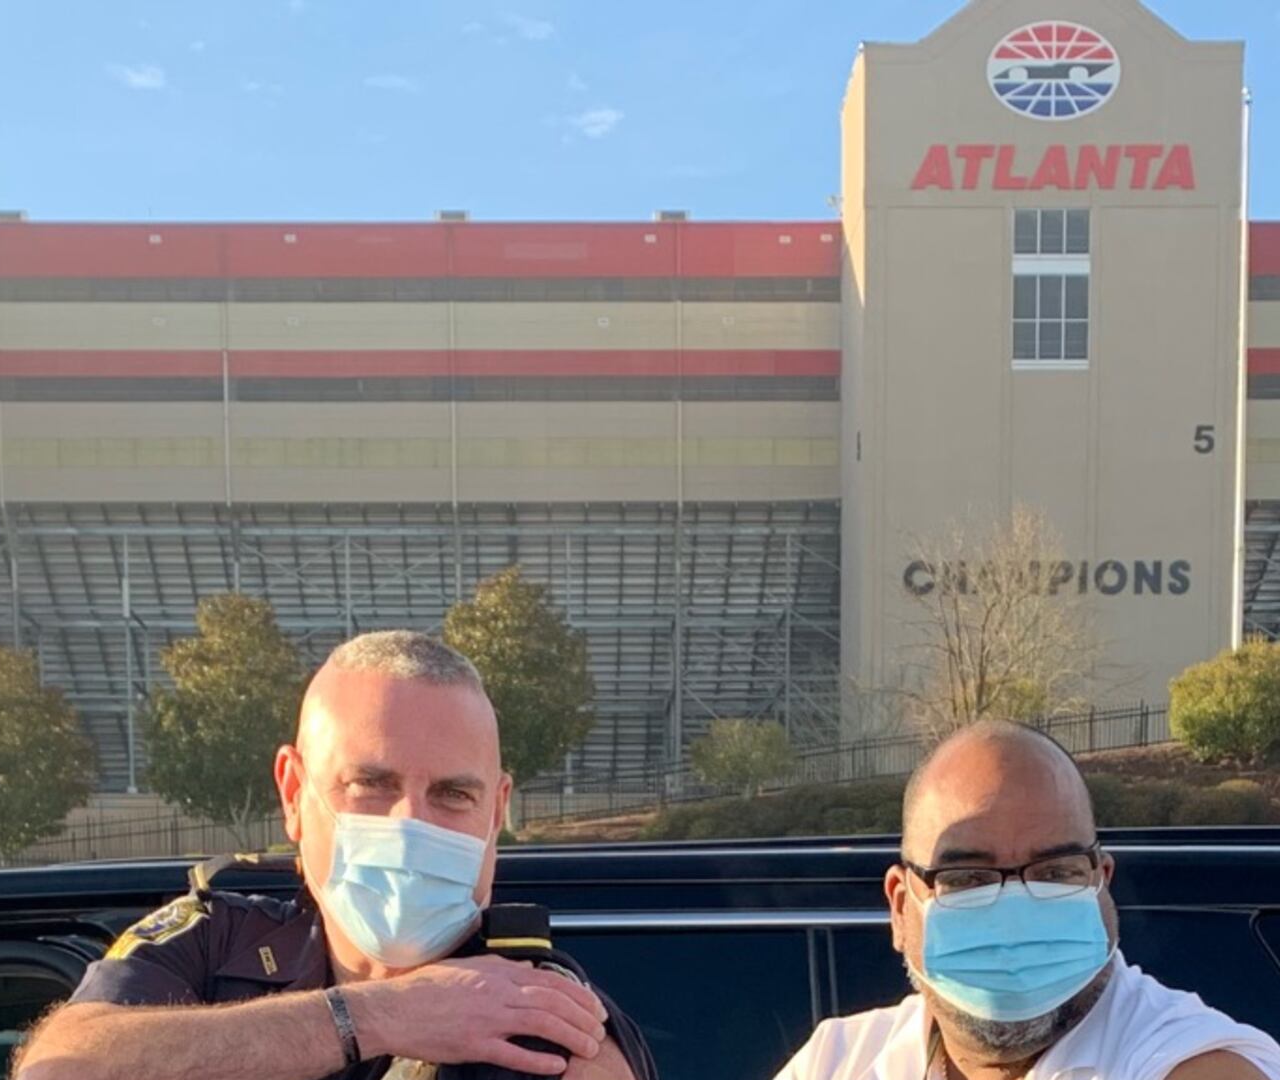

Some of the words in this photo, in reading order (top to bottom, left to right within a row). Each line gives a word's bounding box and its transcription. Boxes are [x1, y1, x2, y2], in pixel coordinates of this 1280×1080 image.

[910, 143, 1196, 191] ATLANTA
[1193, 425, 1215, 454] 5
[903, 559, 1191, 595] CHPIONS
